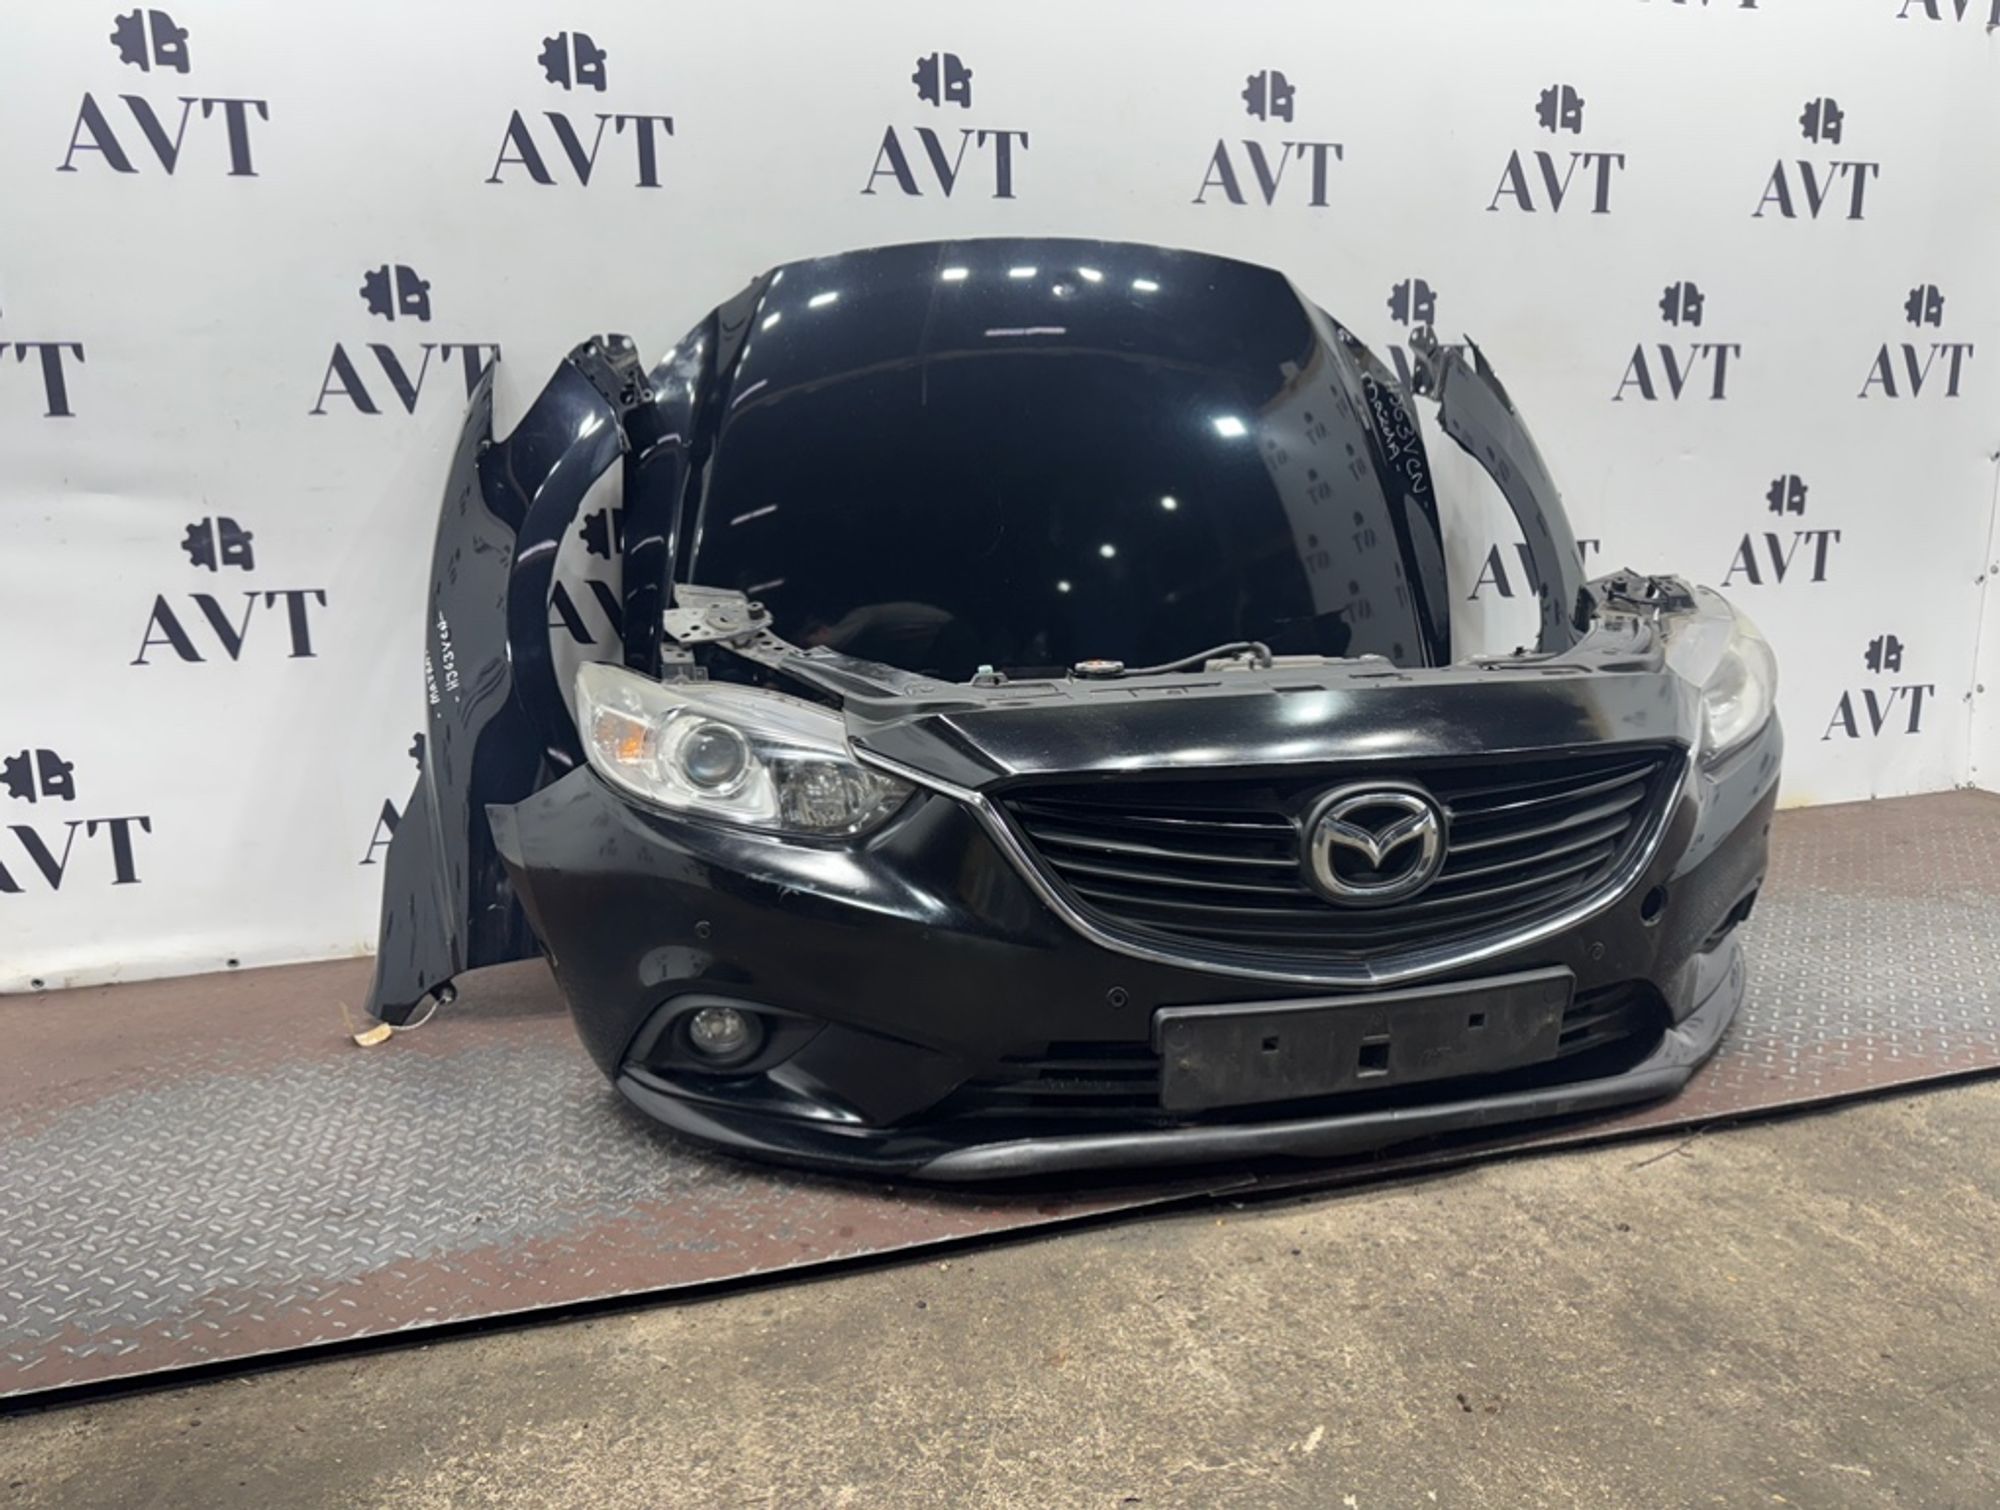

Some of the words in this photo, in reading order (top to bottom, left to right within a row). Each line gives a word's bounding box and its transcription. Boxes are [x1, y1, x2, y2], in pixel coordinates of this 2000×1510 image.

[57, 93, 268, 176] AVT
[486, 110, 673, 187] AVT
[861, 126, 1028, 198] AVT
[1193, 140, 1342, 206] AVT
[1487, 150, 1624, 213] AVT
[1753, 160, 1878, 219] AVT
[1612, 343, 1741, 401] AVT
[1857, 343, 1974, 397] AVT
[1721, 530, 1841, 587] AVT
[131, 589, 326, 665] AVT
[1822, 684, 1935, 740] AVT
